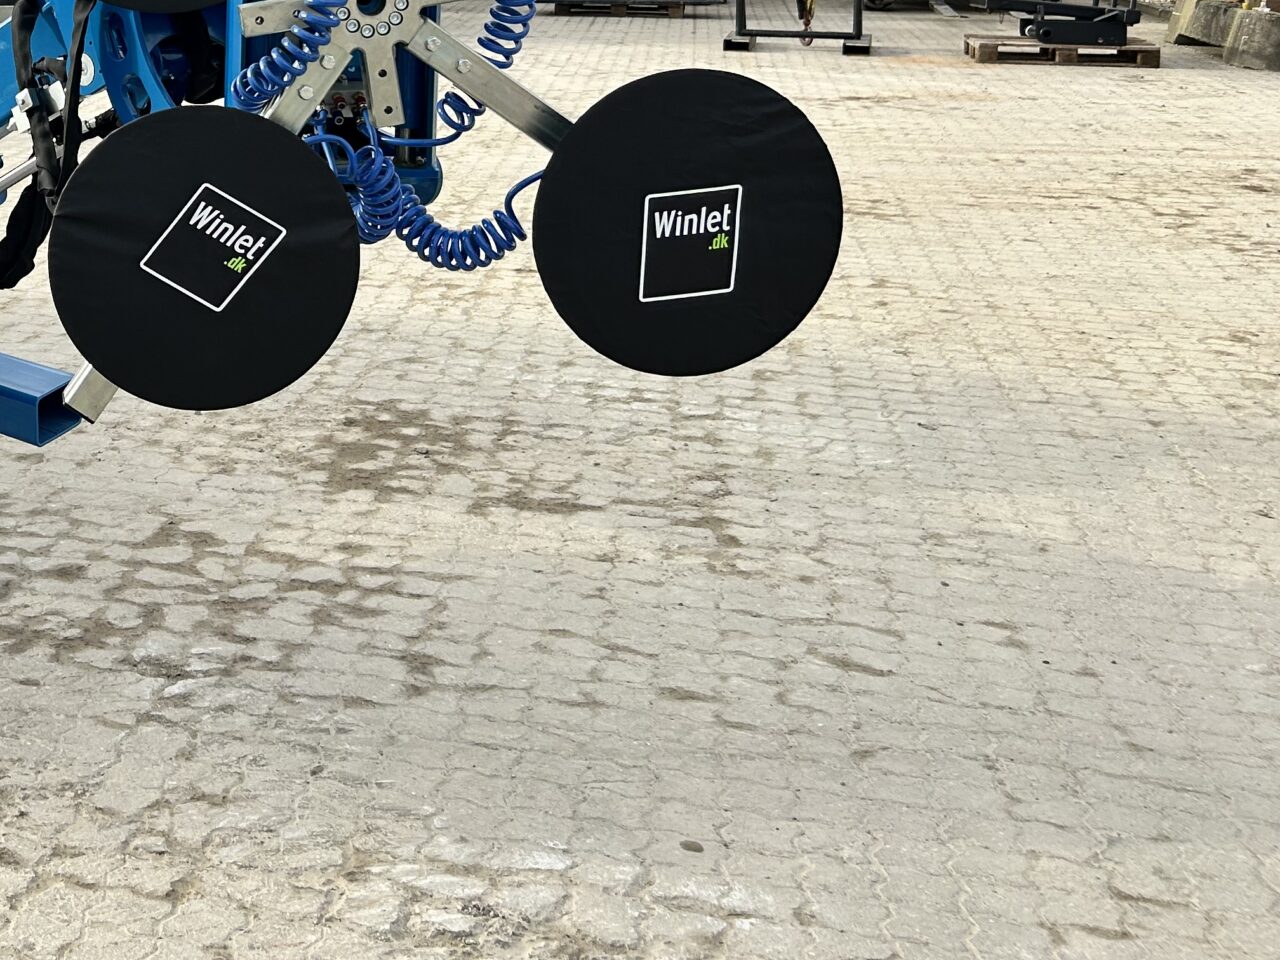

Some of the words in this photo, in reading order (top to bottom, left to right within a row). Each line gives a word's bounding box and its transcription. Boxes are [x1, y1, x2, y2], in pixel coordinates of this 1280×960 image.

[188, 201, 267, 260] Winlet
[654, 203, 731, 239] Winlet
[708, 233, 729, 250] .dk
[223, 256, 247, 273] .dk
